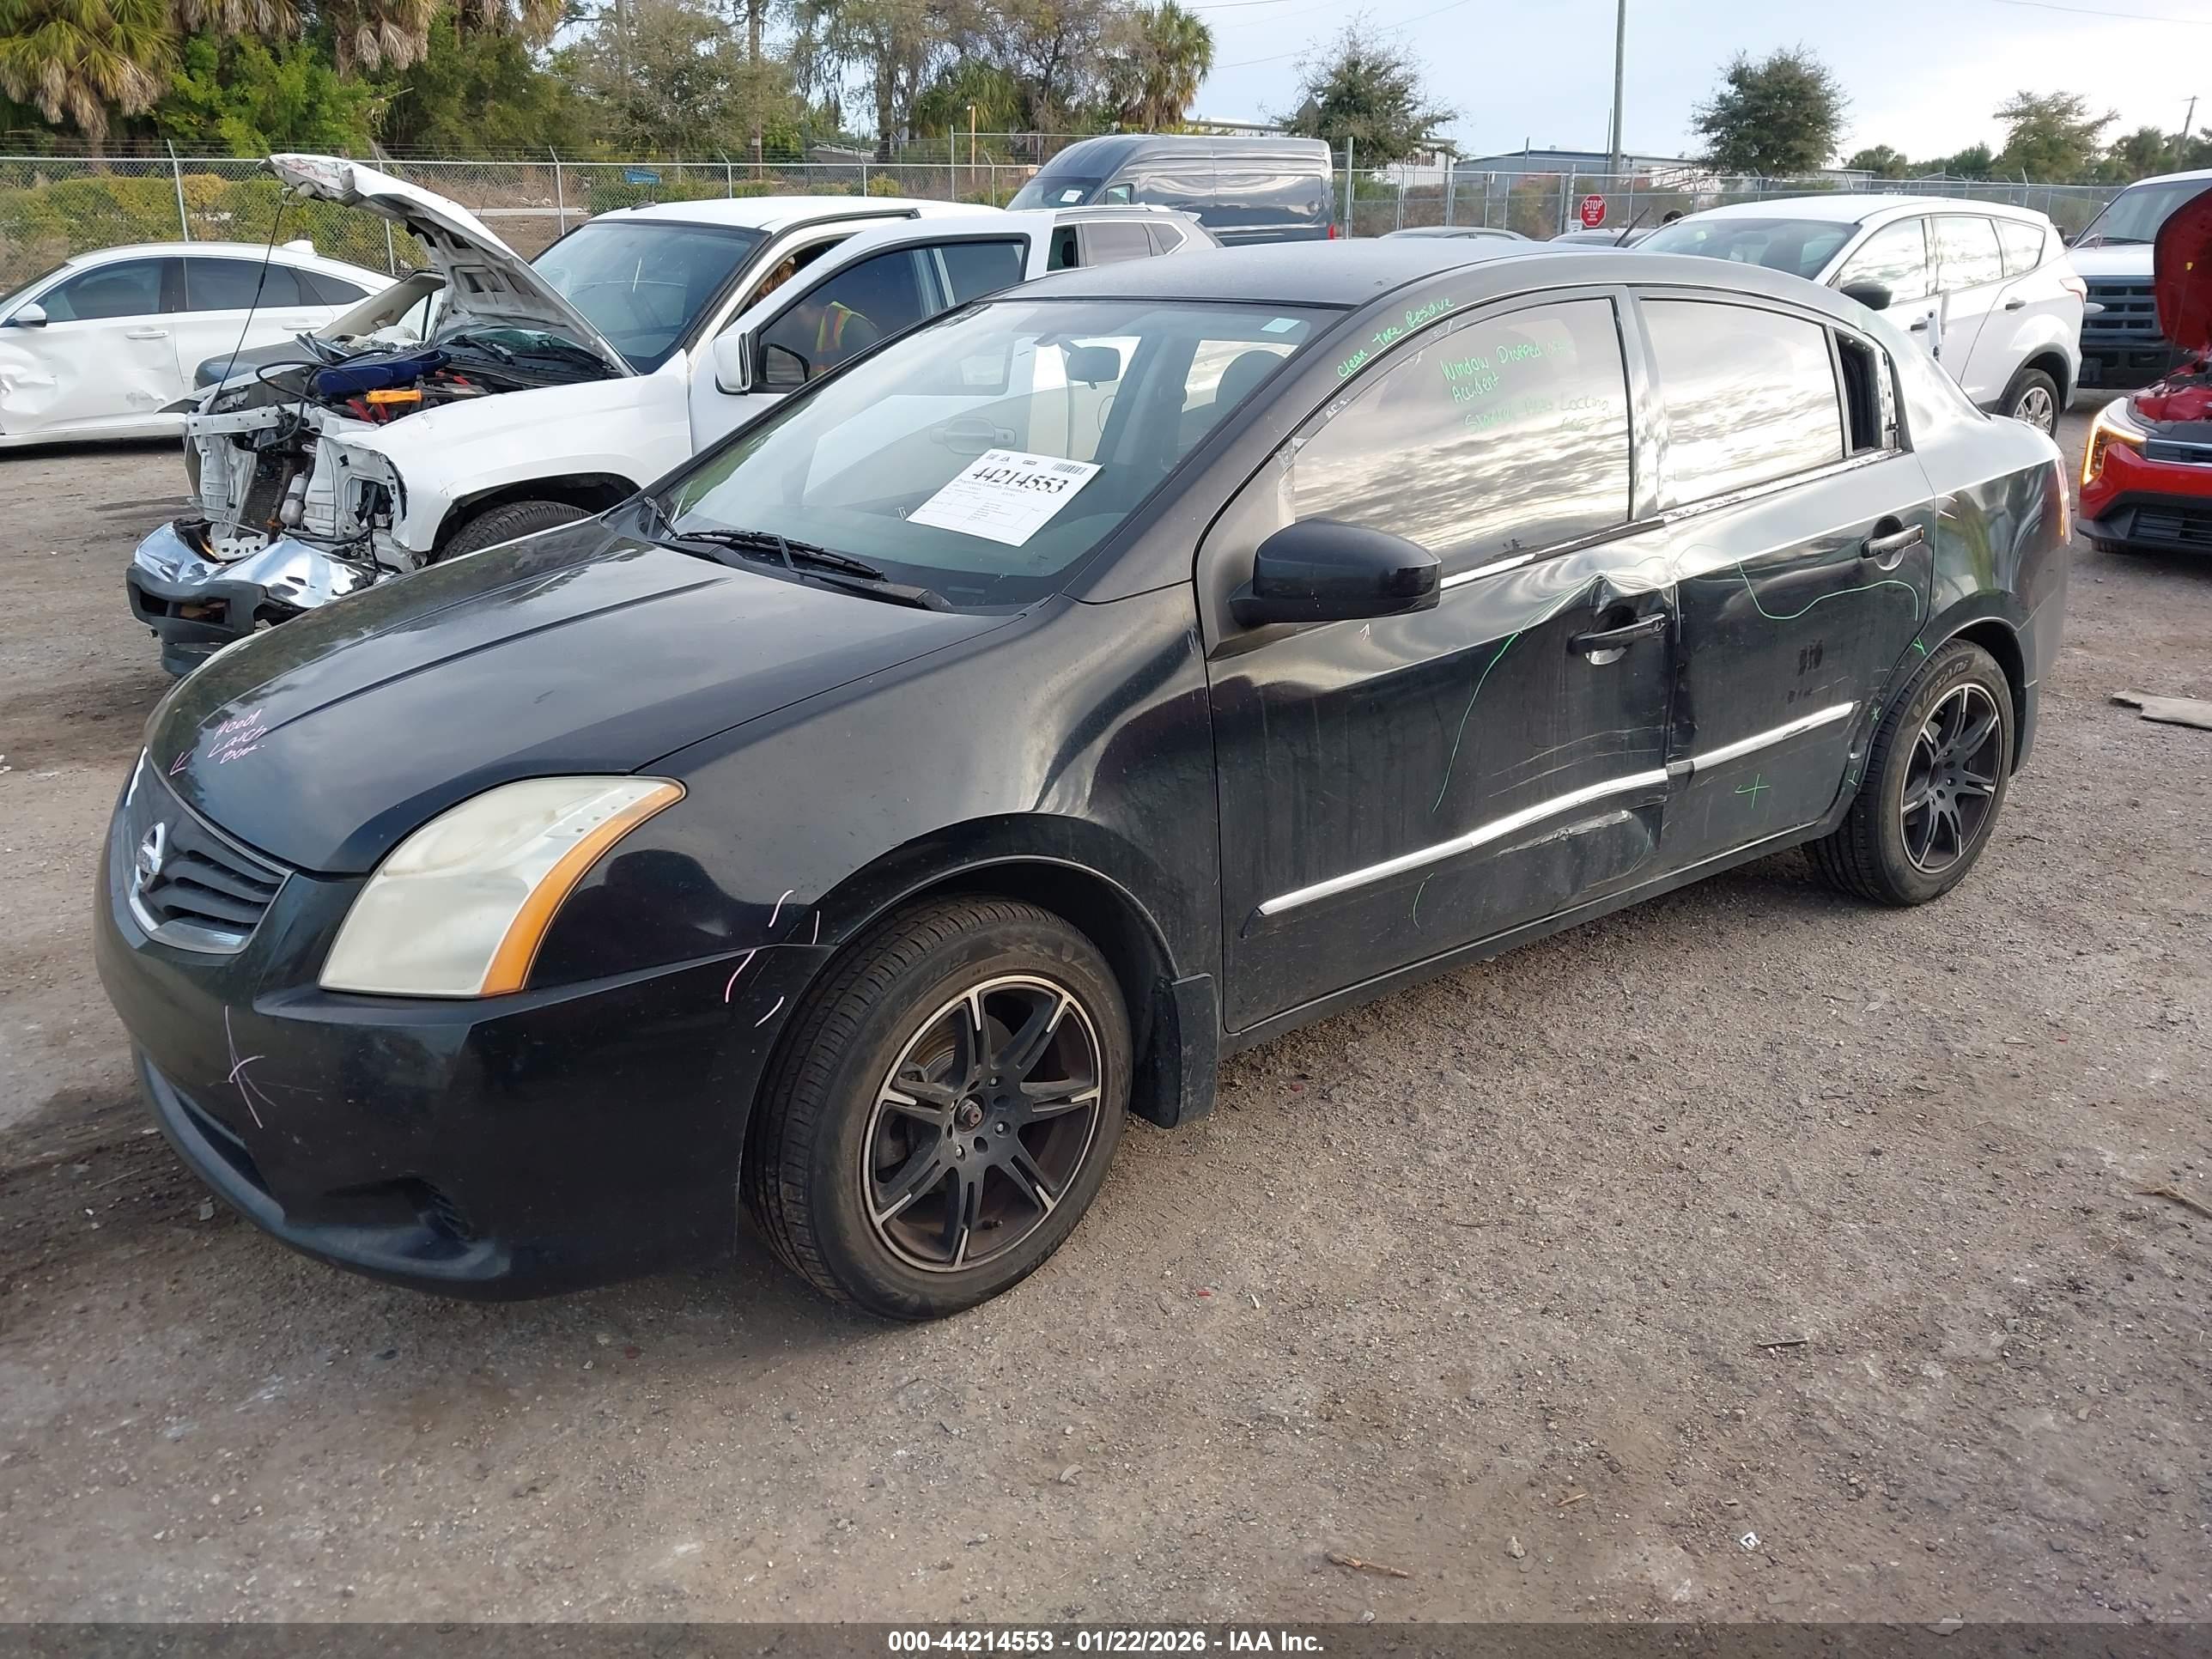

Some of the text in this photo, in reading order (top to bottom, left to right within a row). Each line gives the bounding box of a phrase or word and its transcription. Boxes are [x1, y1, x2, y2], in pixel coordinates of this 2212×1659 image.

[1583, 199, 1603, 210] STOP
[1337, 349, 1369, 377] Clean
[1440, 356, 1490, 381] Window
[1496, 342, 1542, 364] Dropped
[1450, 371, 1500, 404] Accident
[971, 466, 1069, 494] 44214553
